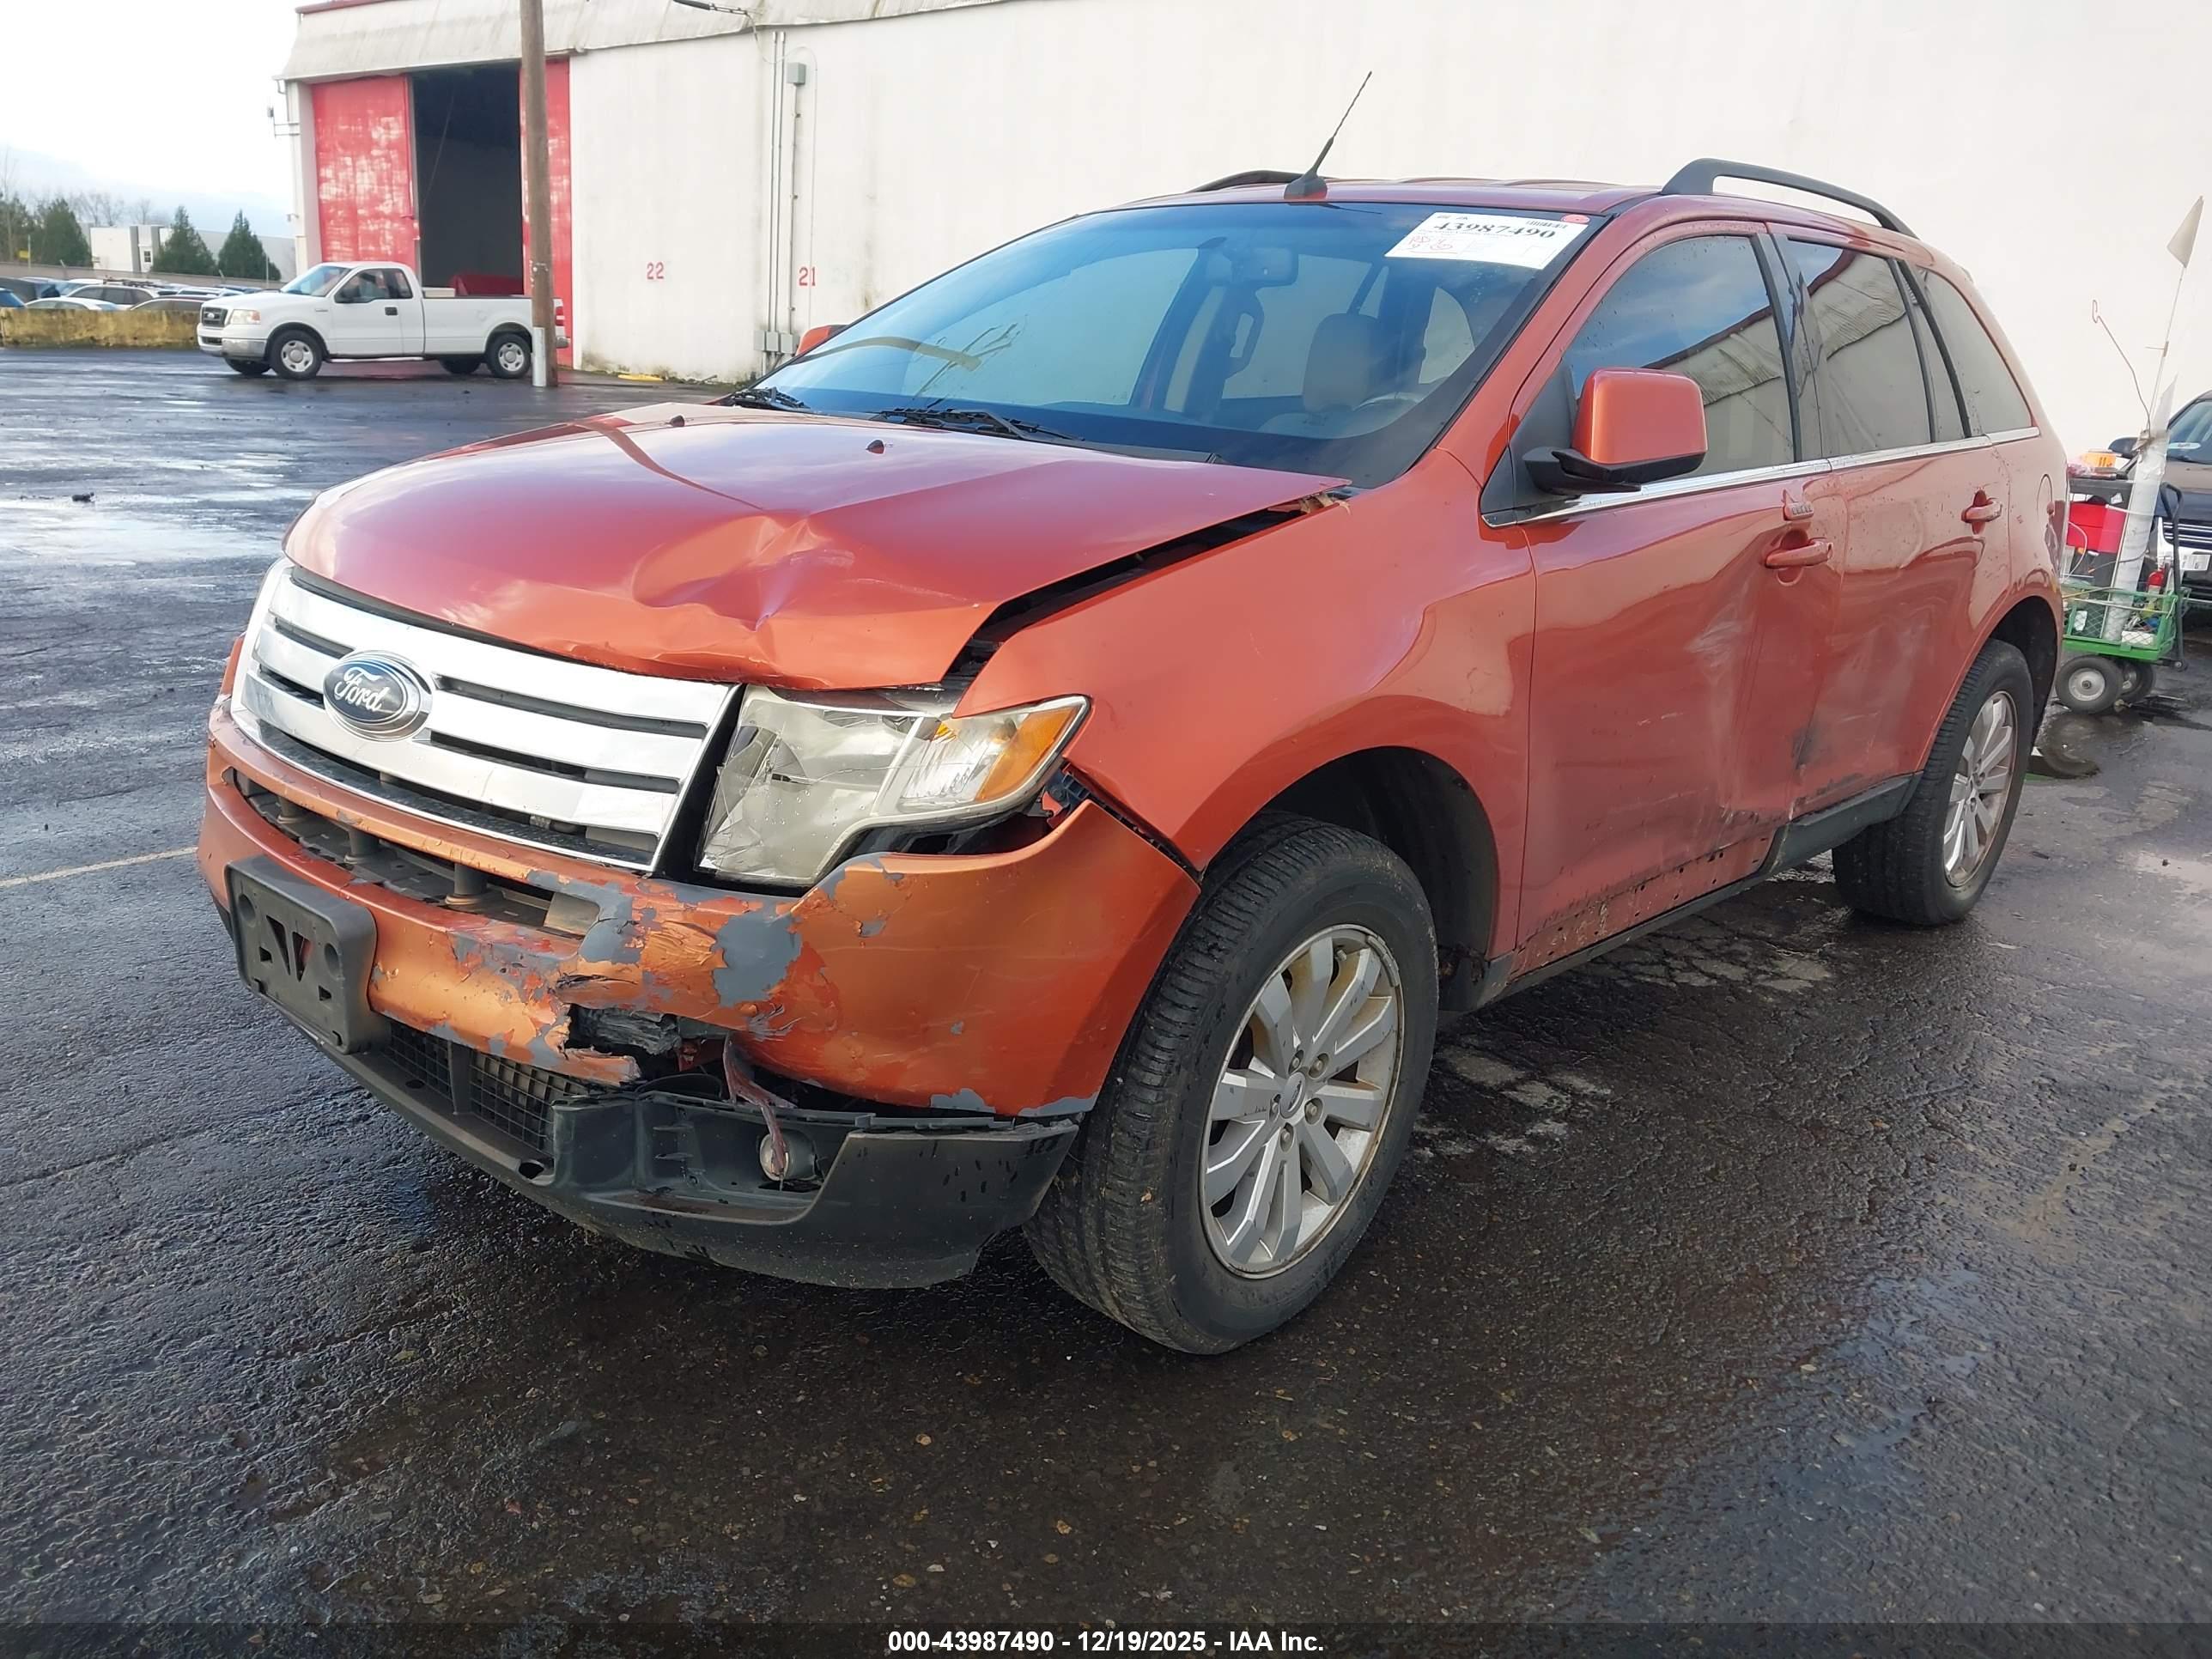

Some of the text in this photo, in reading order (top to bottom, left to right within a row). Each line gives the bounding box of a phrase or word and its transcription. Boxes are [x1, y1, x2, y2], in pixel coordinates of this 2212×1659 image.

[1433, 222, 1556, 239] 43987490
[647, 261, 665, 280] 22
[799, 267, 817, 287] 21
[333, 666, 392, 712] Ford
